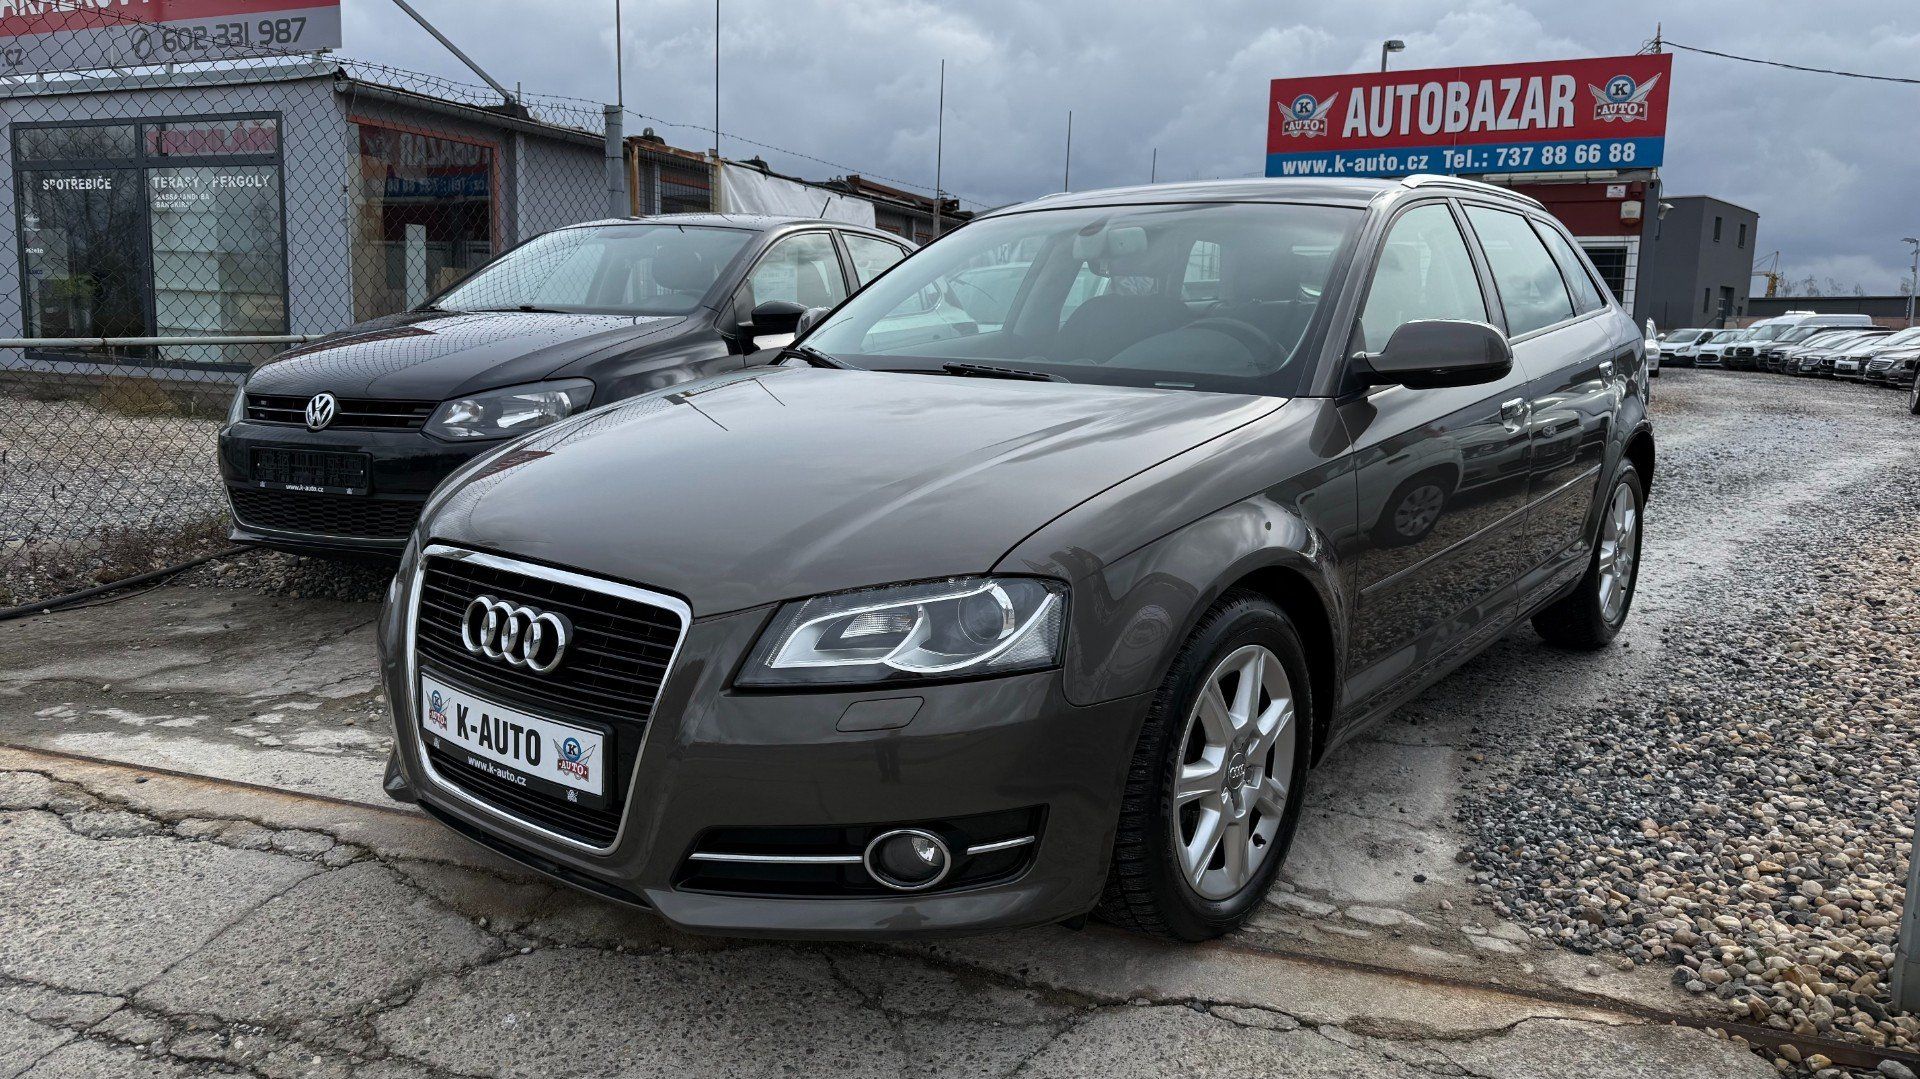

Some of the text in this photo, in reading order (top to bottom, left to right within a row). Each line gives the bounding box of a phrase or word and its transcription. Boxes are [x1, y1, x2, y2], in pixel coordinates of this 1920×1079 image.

[162, 17, 306, 52] 602 331 987
[1613, 83, 1628, 95] K
[1298, 101, 1311, 113] K
[1342, 74, 1577, 138] AUTOBAZAR
[1600, 102, 1638, 115] AUTO
[1288, 119, 1319, 131] AUTO
[1282, 142, 1636, 175] www.k-auto.cz Tel.: 737 88 66 88
[42, 175, 112, 190] SPOTŘEBIČE
[152, 174, 270, 188] TERASY PERGOLY
[456, 703, 541, 766] K-AUTO
[468, 755, 527, 787] www.k-auto.cz
[561, 760, 584, 775] AUTO
